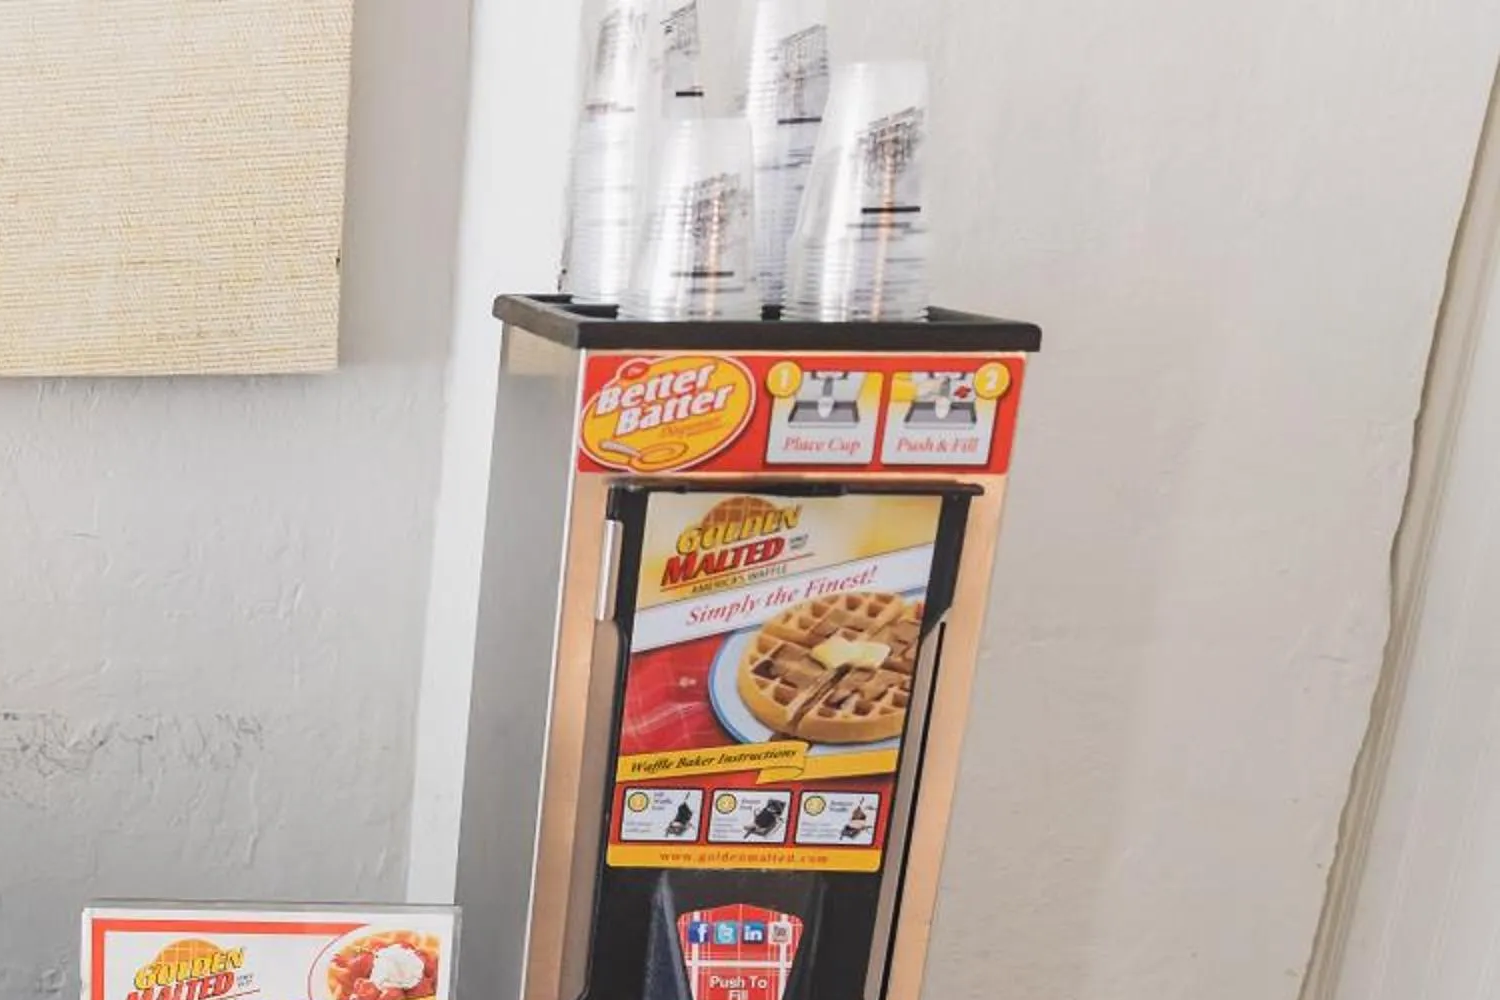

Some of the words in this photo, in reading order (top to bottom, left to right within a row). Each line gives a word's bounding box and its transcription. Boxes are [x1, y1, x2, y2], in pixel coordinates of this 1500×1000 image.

[596, 364, 716, 417] Better
[779, 370, 790, 389] 1
[985, 370, 1000, 391] 2
[615, 384, 736, 437] Batter
[783, 438, 826, 453] Place
[828, 438, 861, 455] Cup
[897, 437, 935, 453] Push
[950, 437, 980, 453] Fill
[675, 504, 803, 555] GOLDEN
[660, 536, 787, 587] MALTED
[685, 591, 761, 626] Simply
[764, 586, 800, 607] the
[804, 565, 879, 600] Finest!
[631, 757, 673, 774] Waffle
[676, 754, 715, 769] Baker
[718, 747, 798, 766] Instructions
[134, 947, 244, 991] GOLDEN
[710, 975, 745, 988] Push
[749, 975, 767, 988] To
